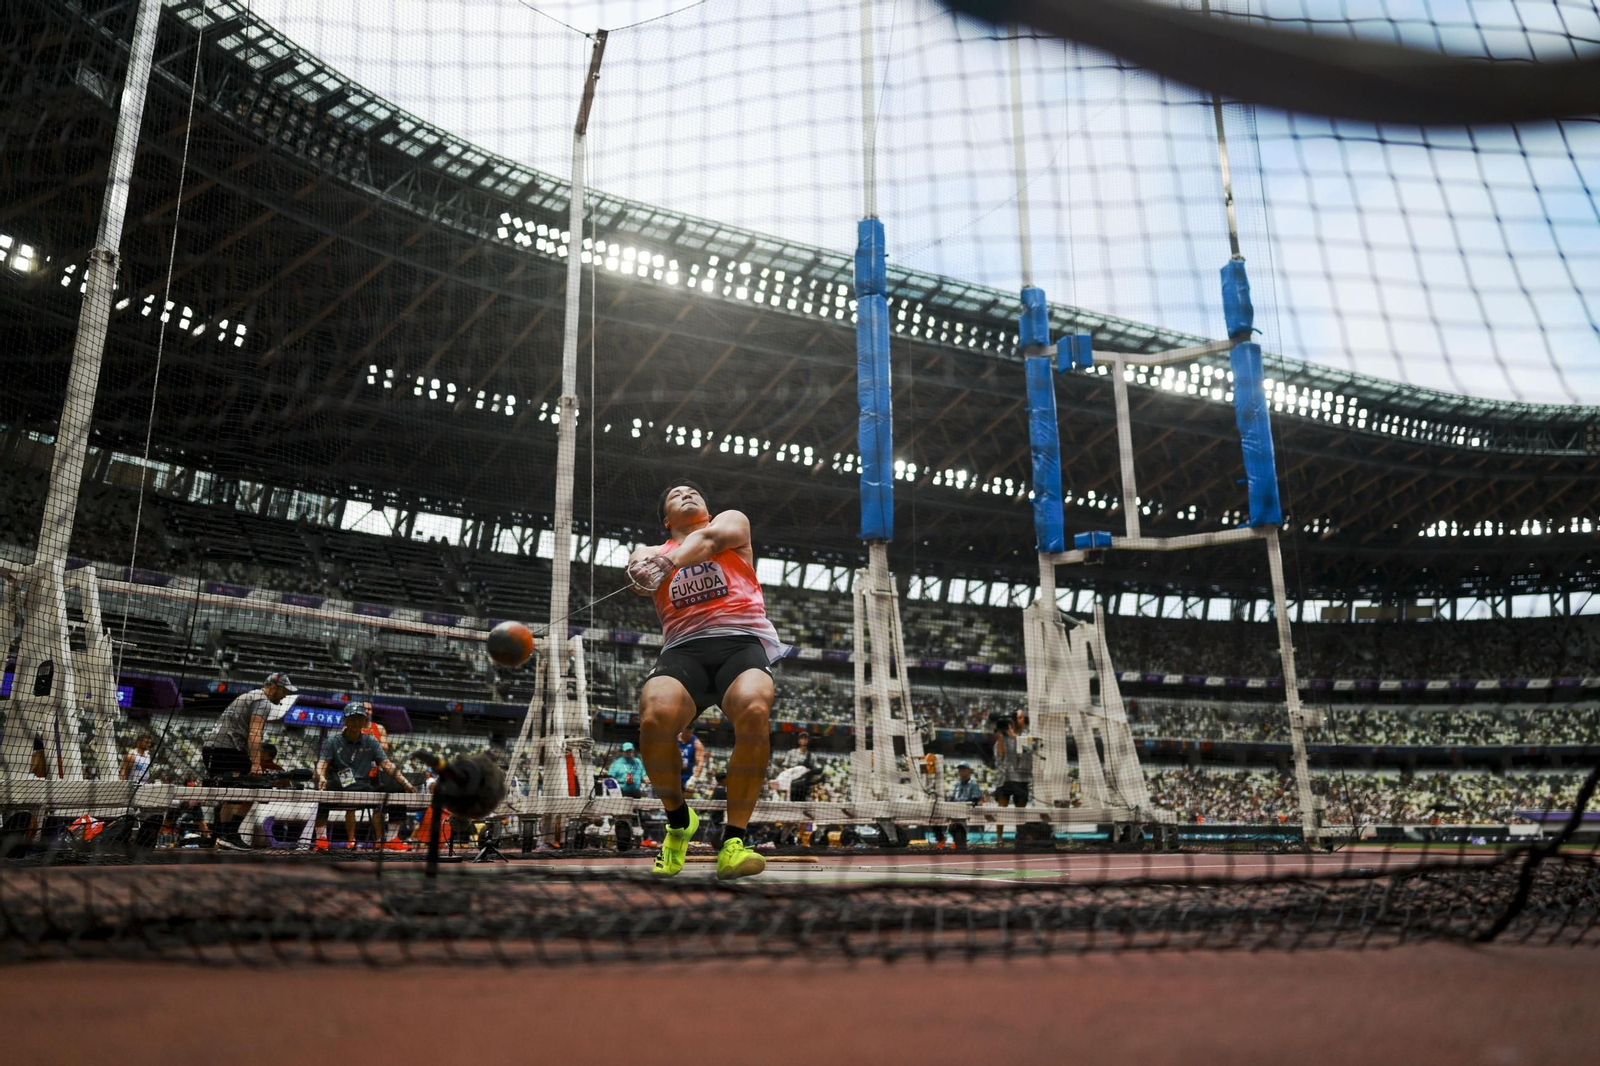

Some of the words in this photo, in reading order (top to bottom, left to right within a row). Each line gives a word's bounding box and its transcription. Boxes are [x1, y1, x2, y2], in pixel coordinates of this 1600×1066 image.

[680, 562, 718, 579] TDK
[671, 574, 724, 599] FUKUDA
[309, 712, 343, 724] TOKY
